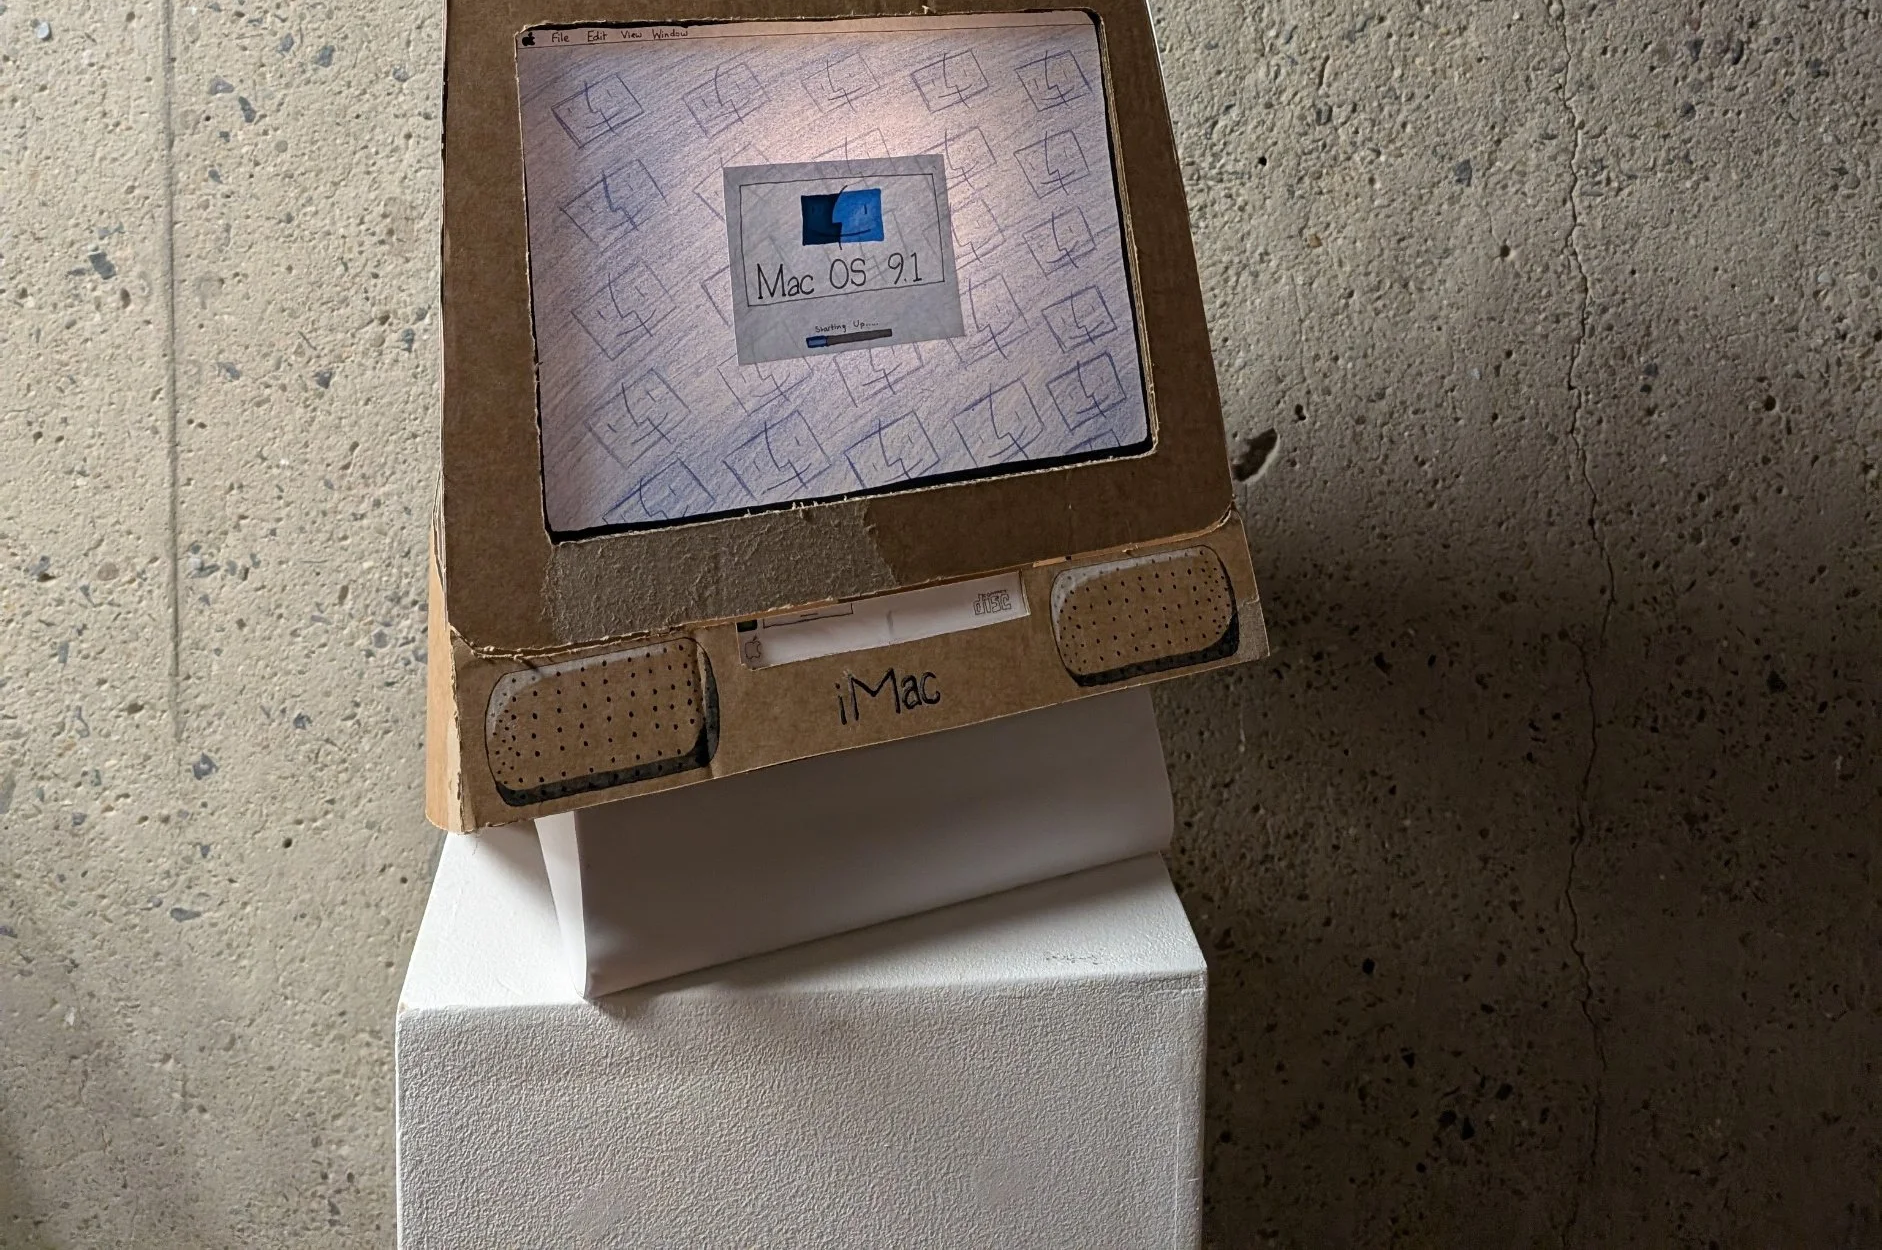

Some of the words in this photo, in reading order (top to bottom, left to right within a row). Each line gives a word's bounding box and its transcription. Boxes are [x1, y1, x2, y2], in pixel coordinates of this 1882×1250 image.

[551, 32, 570, 43] File
[587, 30, 607, 42] Edit
[620, 30, 643, 39] View
[652, 28, 689, 40] Window
[757, 263, 815, 299] Mac
[829, 258, 867, 289] OS
[888, 252, 922, 285] 9.1
[815, 324, 847, 333] Starting
[835, 667, 941, 725] iMac
